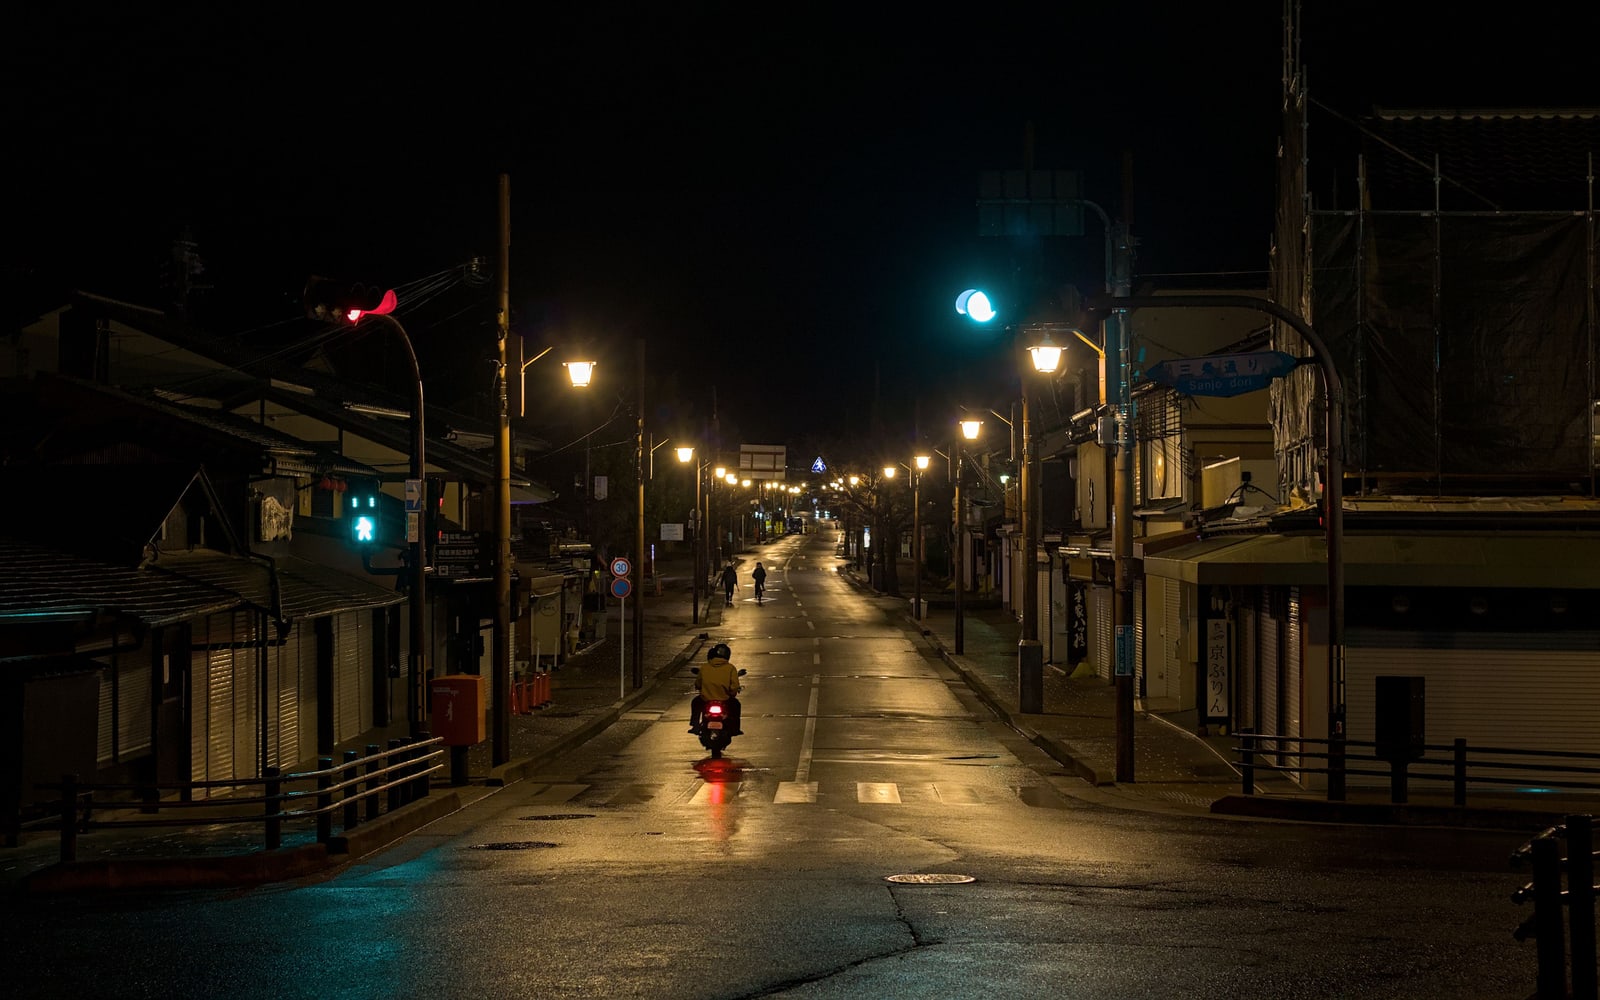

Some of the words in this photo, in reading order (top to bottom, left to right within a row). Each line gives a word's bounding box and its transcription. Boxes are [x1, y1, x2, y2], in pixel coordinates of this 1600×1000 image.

[1190, 379, 1223, 391] Sanjo
[1230, 376, 1252, 388] dori
[615, 564, 627, 573] 30
